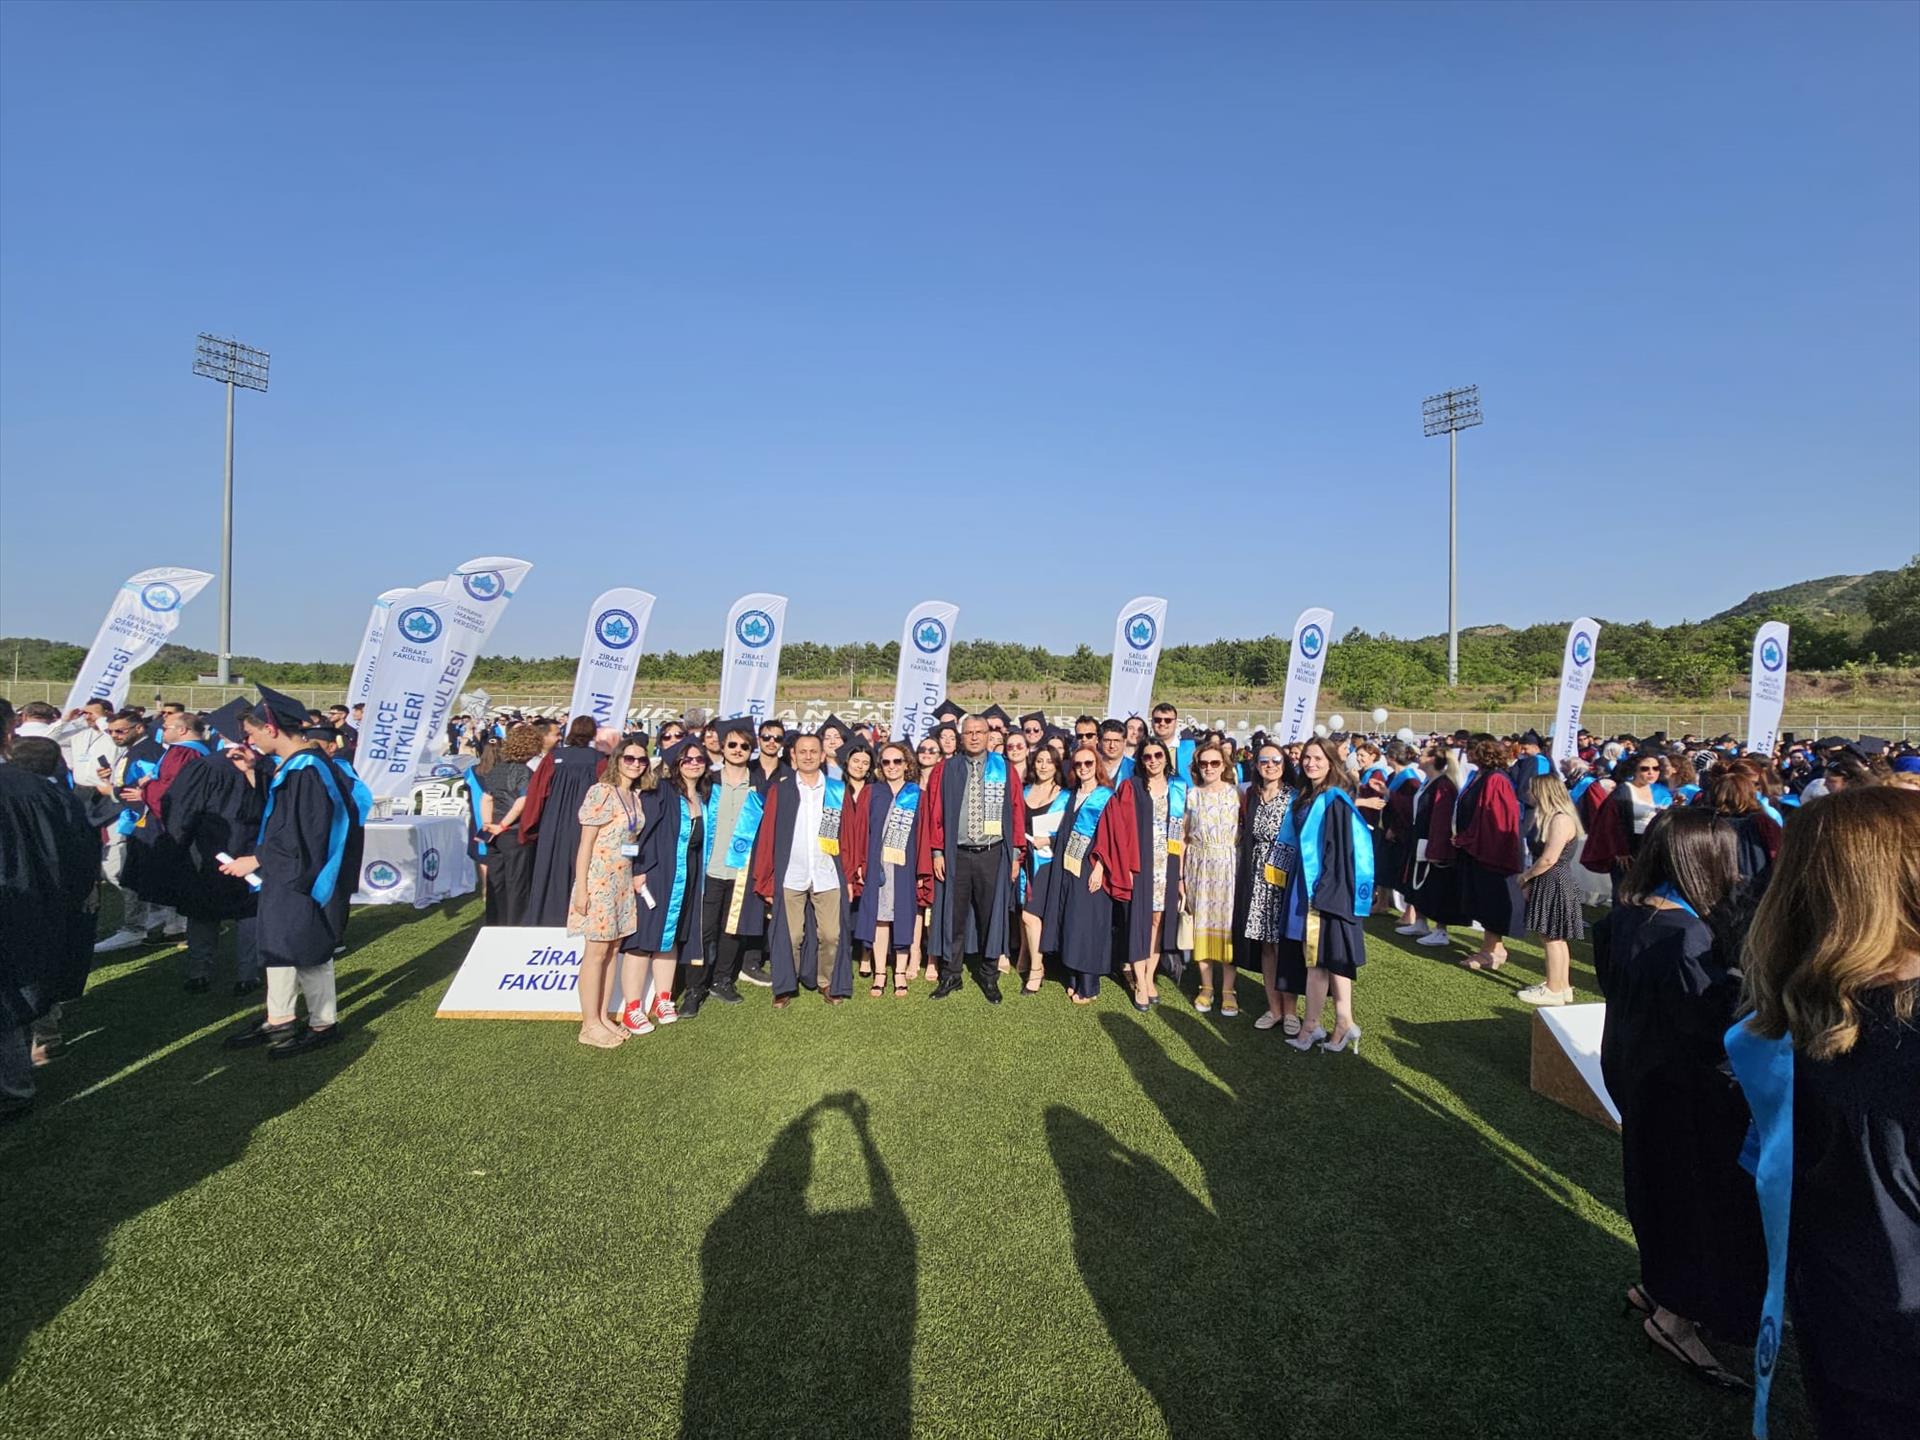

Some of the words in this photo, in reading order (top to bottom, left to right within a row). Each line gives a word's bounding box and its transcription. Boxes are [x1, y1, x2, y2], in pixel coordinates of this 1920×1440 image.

[392, 651, 434, 665] FAKÜLTESİ
[401, 645, 428, 657] ZİRAAT
[598, 653, 625, 664] ZİRAAT
[89, 647, 134, 701] ÜLTESİ
[590, 658, 629, 673] FAKÜLTESİ
[369, 700, 398, 761] BAHÇE
[389, 691, 425, 774] BİTKİLERİ
[526, 946, 583, 966] ZİRA
